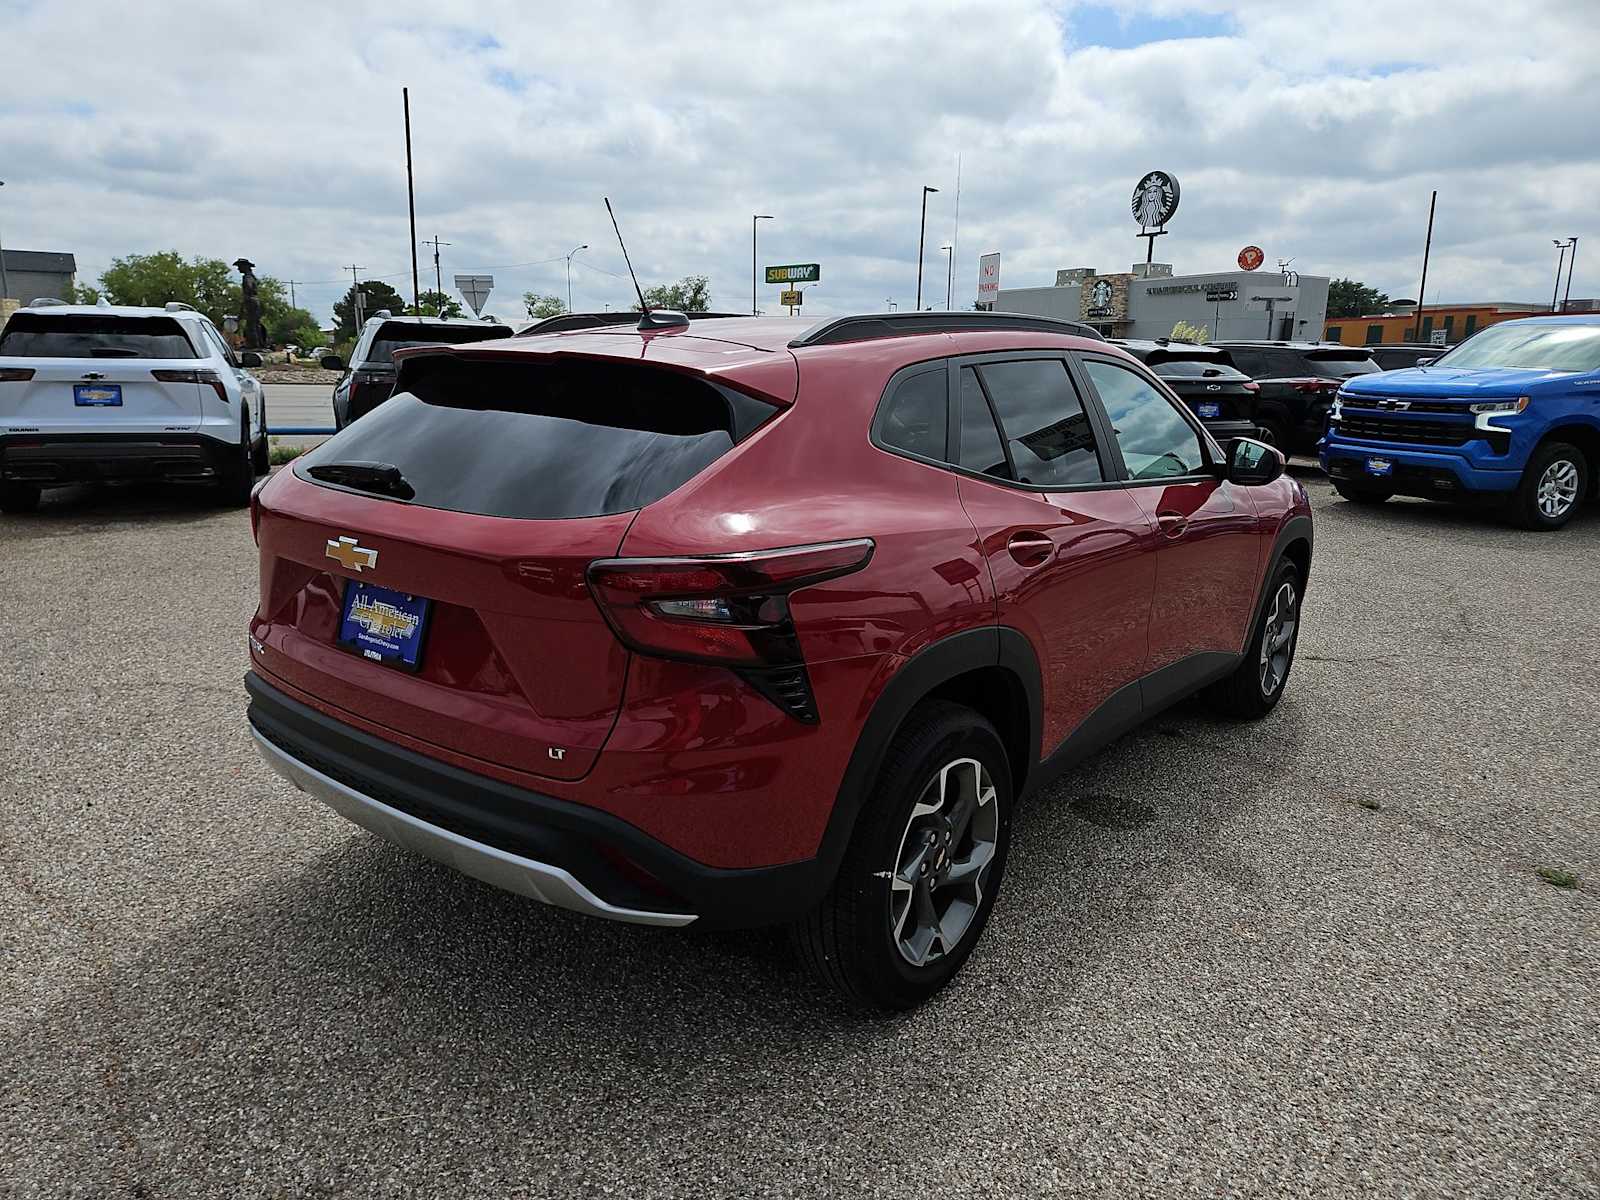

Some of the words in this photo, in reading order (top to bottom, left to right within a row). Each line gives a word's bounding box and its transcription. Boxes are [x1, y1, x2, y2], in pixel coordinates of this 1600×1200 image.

[768, 267, 813, 281] SUBWAY
[984, 264, 994, 276] NO
[351, 593, 368, 609] All
[369, 598, 419, 625] American
[359, 616, 403, 639] Chevrolet
[548, 747, 566, 760] LT
